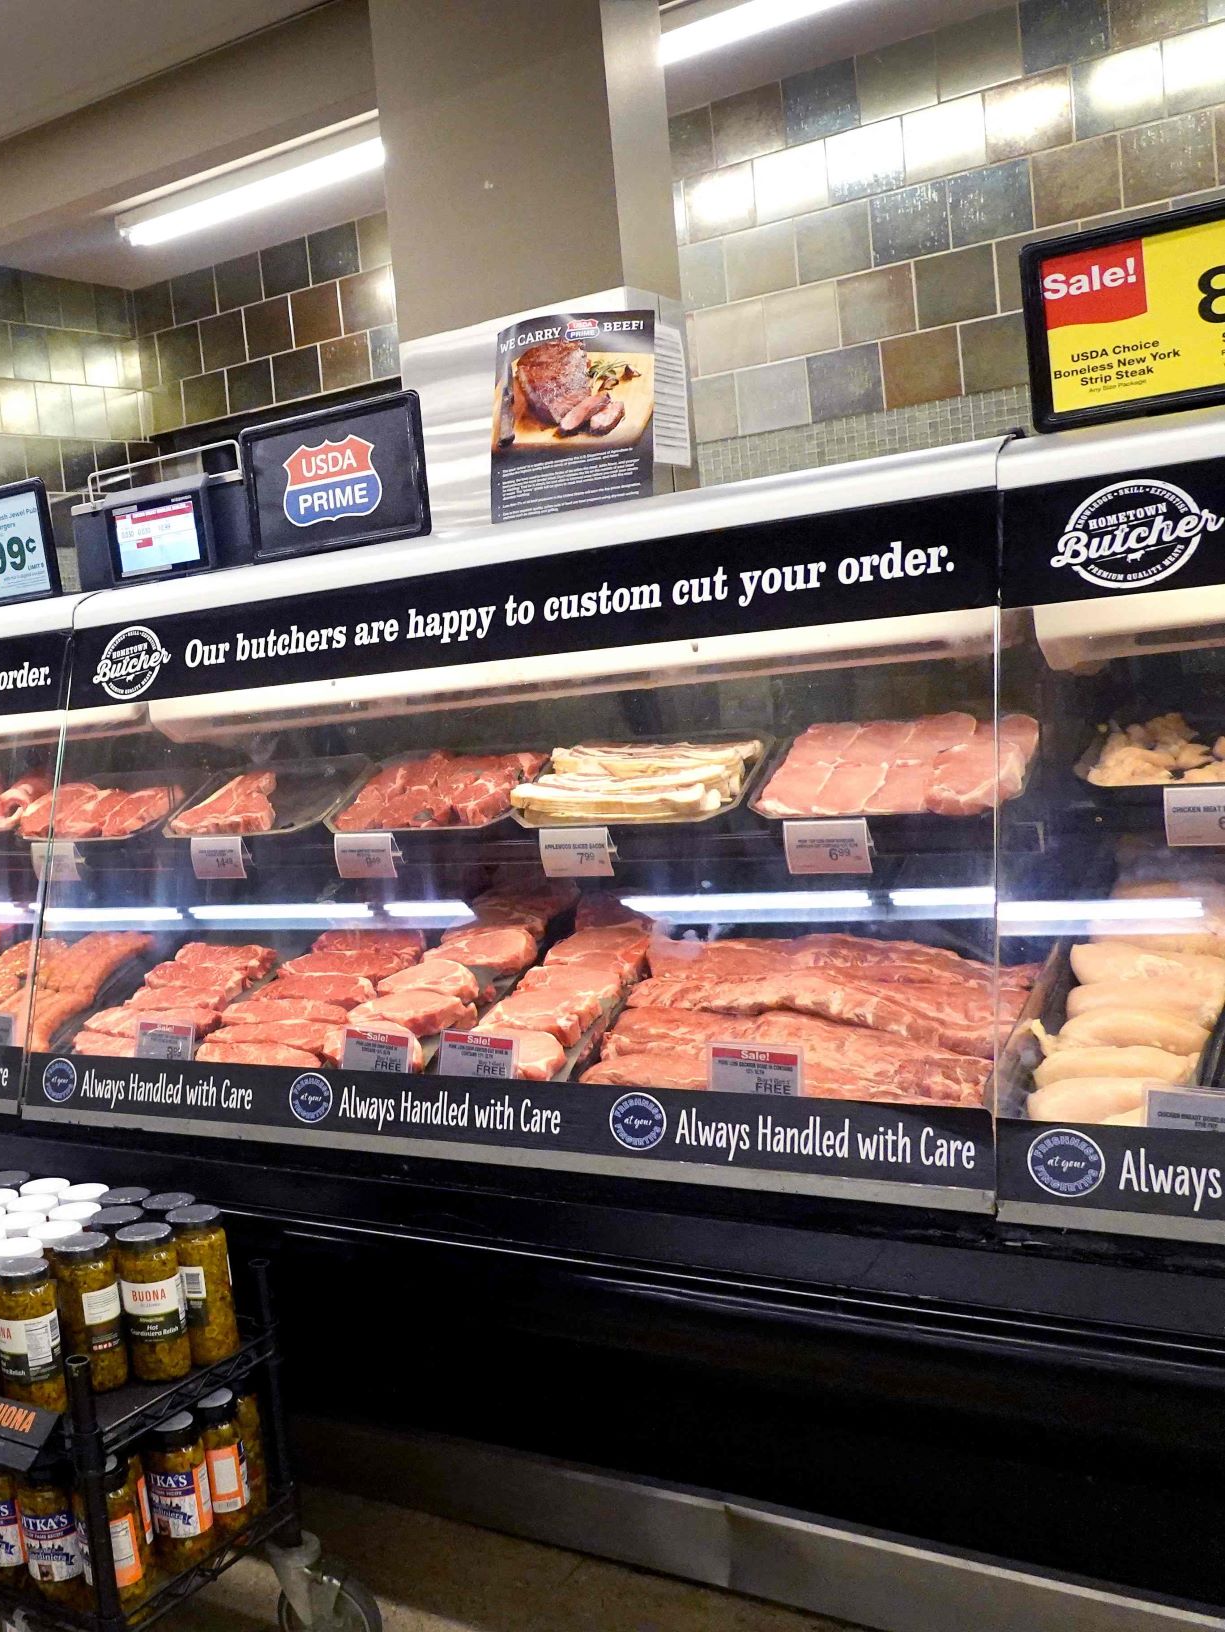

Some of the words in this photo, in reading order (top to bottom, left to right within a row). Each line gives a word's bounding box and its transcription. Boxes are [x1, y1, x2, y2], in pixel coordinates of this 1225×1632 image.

[1042, 257, 1137, 300] Sale!
[570, 329, 595, 338] PRIME
[603, 320, 644, 332] BEEF!
[499, 338, 516, 354] WE
[517, 326, 562, 346] CARRY
[1070, 348, 1109, 364] USDA
[1112, 339, 1161, 356] Choice
[1053, 362, 1114, 380] Boneless
[1117, 355, 1147, 369] New
[1150, 348, 1182, 363] York
[1080, 374, 1112, 388] Strip
[1115, 366, 1154, 381] Steak
[301, 448, 358, 478] USDA
[298, 482, 369, 515] PRIME
[1075, 492, 1114, 529] KNOWLEDGE
[1118, 485, 1145, 496] SKILL
[1149, 487, 1189, 514] EXPERTISE
[1087, 502, 1168, 531] HOMETOWN
[1050, 508, 1225, 568] Butcher
[1087, 564, 1124, 581] PREMIUM
[1126, 564, 1164, 581] QUALITY
[1164, 544, 1185, 567] MEATS
[184, 638, 230, 668] Our
[235, 625, 347, 662] butchers
[354, 618, 400, 645] are
[406, 605, 496, 643] happy
[504, 594, 535, 627] to
[543, 582, 662, 622] custom
[671, 565, 729, 605] cut
[738, 560, 827, 608] your
[837, 540, 955, 585] order.
[112, 642, 148, 659] HOMETOWN
[92, 647, 172, 684] Butcher
[367, 1032, 389, 1043] Sale!
[467, 1035, 491, 1046] Sale!
[374, 1060, 401, 1072] FREE
[740, 1050, 770, 1061] Sale!
[476, 1064, 506, 1076] FREE
[80, 1068, 125, 1109] Always
[128, 1073, 183, 1104] Handled
[186, 1076, 216, 1107] with
[221, 1079, 253, 1110] Care
[300, 1093, 308, 1101] at
[308, 1094, 322, 1105] your
[755, 1082, 792, 1095] FREE
[338, 1085, 395, 1131] Always
[399, 1090, 470, 1127] Handled
[474, 1093, 514, 1131] with
[520, 1098, 561, 1135] Care
[623, 1115, 635, 1124] at
[634, 1116, 653, 1129] your
[675, 1107, 751, 1162] Always
[757, 1115, 849, 1158] Handled
[857, 1122, 911, 1164] with
[919, 1126, 976, 1170] Care
[1033, 1135, 1099, 1162] FRESHNESS
[1047, 1155, 1061, 1168] at
[1061, 1159, 1086, 1173] your
[1118, 1147, 1223, 1212] Always
[131, 1287, 168, 1302] BUONA
[162, 1326, 179, 1335] Relish
[151, 1473, 188, 1488] TKA'S
